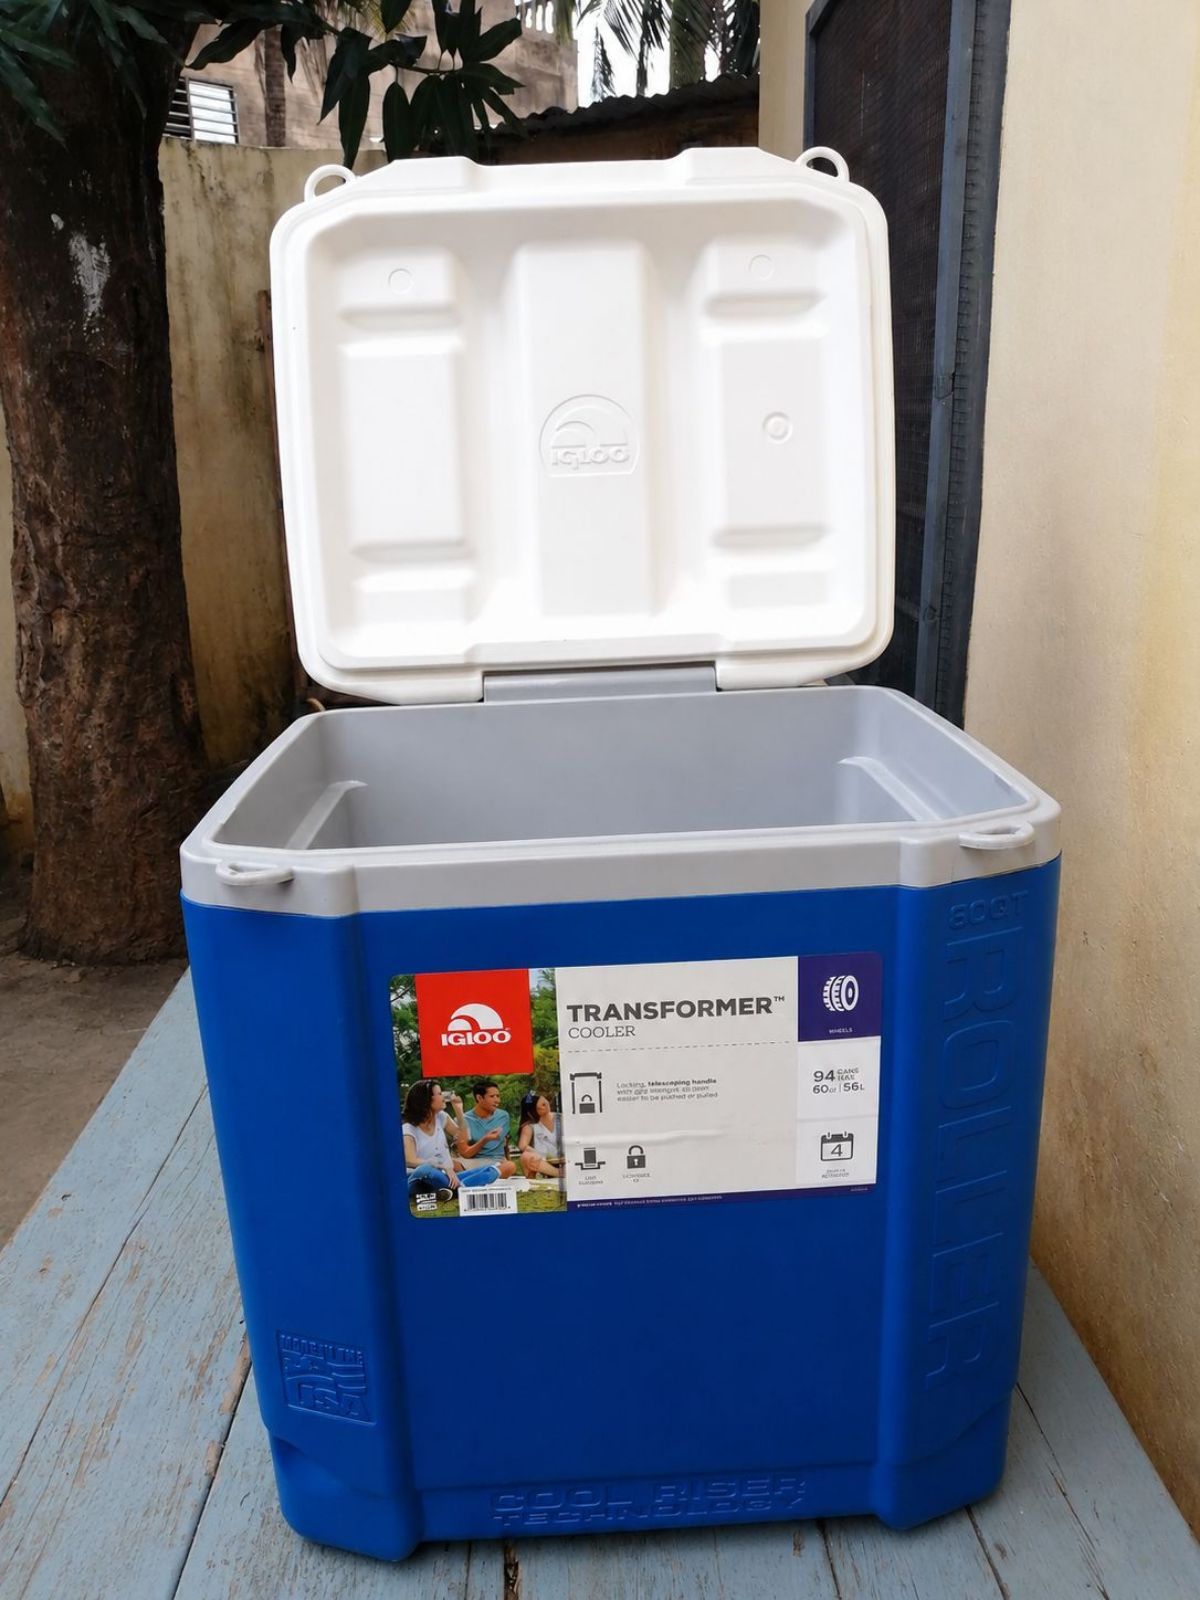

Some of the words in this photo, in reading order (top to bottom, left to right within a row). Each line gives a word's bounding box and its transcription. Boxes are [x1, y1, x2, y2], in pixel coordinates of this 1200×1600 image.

[441, 1030, 512, 1047] IGLOO
[568, 1025, 636, 1039] COOLER
[813, 1070, 836, 1082] 94
[831, 1144, 843, 1157] 4
[924, 926, 1024, 1391] ROLLER
[490, 1486, 633, 1512] COOL
[653, 1474, 806, 1504] RISER
